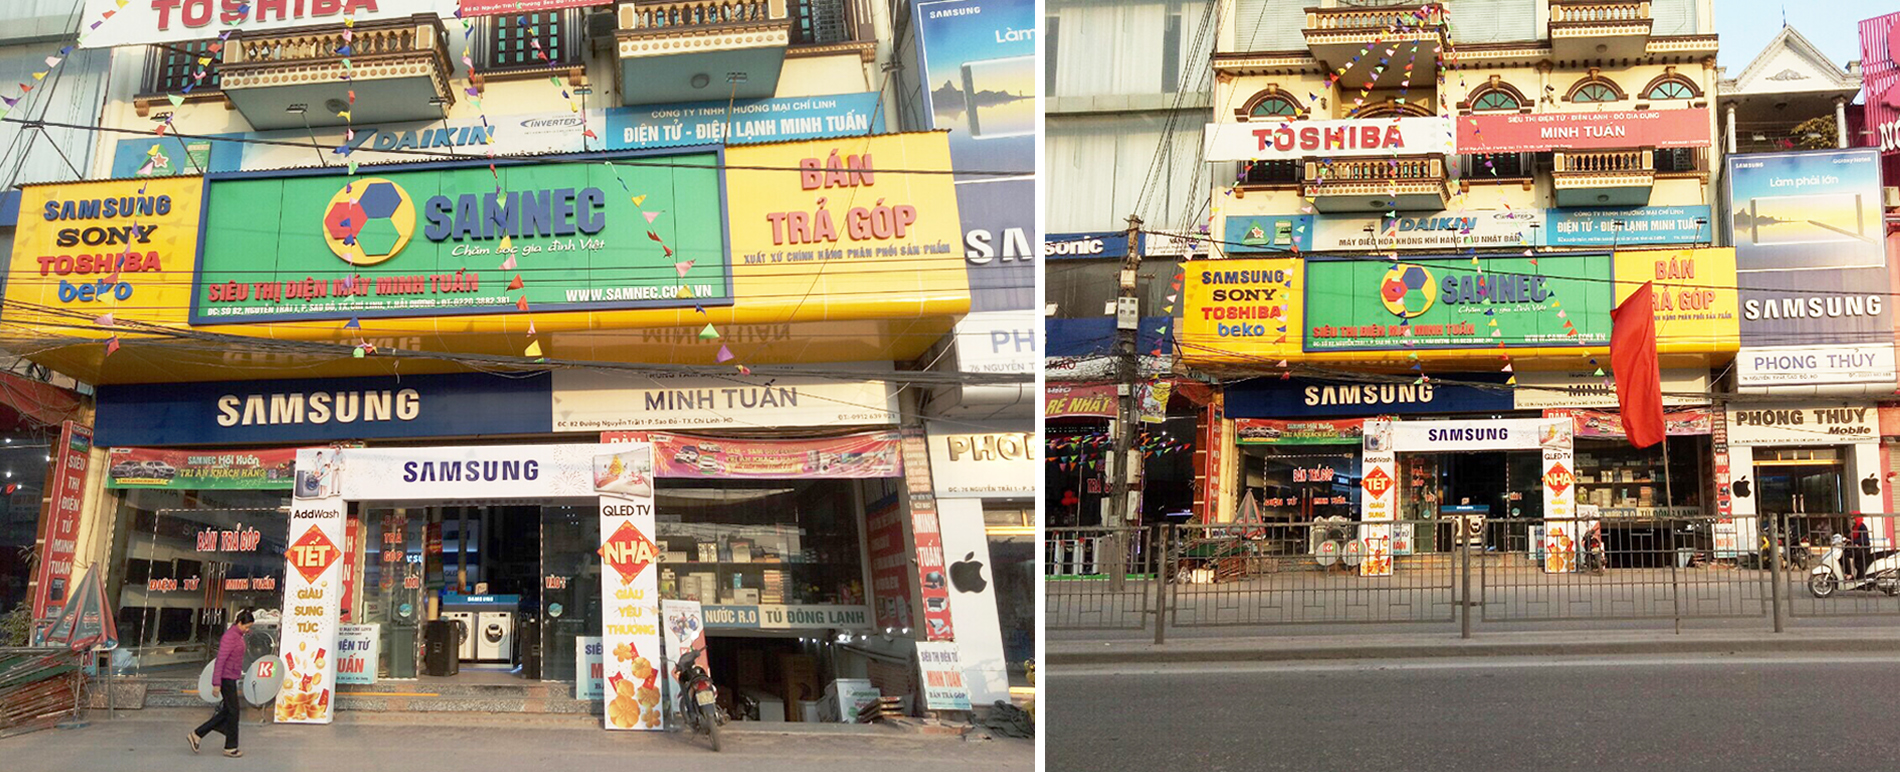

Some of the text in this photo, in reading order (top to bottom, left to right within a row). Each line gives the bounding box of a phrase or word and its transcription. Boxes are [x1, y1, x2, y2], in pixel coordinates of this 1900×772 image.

[930, 6, 981, 19] SAMSUNG
[651, 110, 680, 119] CÔNG
[683, 109, 696, 117] TY
[698, 107, 725, 116] TNHH
[793, 99, 811, 111] CHÍ
[813, 99, 836, 109] LINH
[531, 118, 577, 128] INVERTER
[624, 123, 659, 145] ĐIỆN
[662, 118, 683, 141] TỬ
[736, 119, 776, 140] LẠNH
[780, 116, 826, 134] MINH
[826, 109, 868, 132] TUẤN
[1508, 115, 1523, 123] SIÊU
[372, 125, 495, 150] DAIKIN
[1252, 125, 1405, 152] TOSHIBA
[1540, 121, 1626, 139] MINH TUẤN
[800, 148, 875, 191] BÁN
[1769, 177, 1793, 188] Làm
[1821, 174, 1839, 185] lớn
[43, 194, 171, 221] SAMSUNG
[425, 187, 605, 242] SAMNEC
[766, 196, 917, 245] TRẢ GÓP
[1398, 217, 1477, 232] DAIKIN
[1557, 217, 1675, 234] ĐIỆN TỬ LẠNH MINH
[57, 225, 158, 247] SONY
[1396, 236, 1423, 245] KHÔNG
[1424, 235, 1438, 244] KHÍ
[451, 239, 605, 257] Chăm gia đình Việt
[1045, 236, 1104, 255] sonic
[37, 251, 162, 276] TOSHIBA
[744, 251, 766, 265] XUẤT
[787, 249, 814, 262] CHÍNH
[1655, 255, 1695, 280] BÁN
[208, 267, 479, 303] SIÊU THỊ ĐIỆN MÁY MINH TUẤN
[1201, 270, 1285, 285] SAMSUNG
[1212, 288, 1277, 301] SONY
[1441, 274, 1547, 305] SAMNEC
[1679, 287, 1716, 311] GÓP
[1744, 295, 1882, 320] SAMSUNG
[1201, 305, 1282, 320] TOSHIBA
[1218, 322, 1265, 337] beko
[1312, 320, 1475, 340] SIÊU THỊ ĐIỆN MINH TUẤN
[984, 359, 1025, 371] NGUYỄN
[1754, 347, 1876, 370] PHONG THỦY
[645, 378, 798, 411] MINH TUẤN
[1068, 391, 1113, 413] NHẤT
[1304, 382, 1434, 406] SAMSUNG
[217, 388, 420, 427] SAMSUNG
[1736, 409, 1804, 426] PHONG
[1428, 427, 1509, 442] SAMSUNG
[1829, 426, 1872, 435] Mobile
[68, 454, 86, 471] SIÊU
[187, 456, 216, 465] SAMNEC
[1560, 452, 1572, 460] TV
[403, 459, 540, 482] SAMSUNG
[1545, 469, 1574, 486] NHÀ
[67, 476, 80, 494] THỊ
[1365, 472, 1388, 490] TẾT
[293, 509, 340, 520] AddWash
[603, 504, 651, 517] QLED TV
[914, 514, 938, 533] MINH
[196, 527, 218, 552] BÁN
[221, 522, 239, 551] TRẢ
[240, 526, 260, 551] GÓP
[294, 536, 331, 567] TẾT
[383, 550, 403, 562] GÓP
[604, 536, 654, 564] NHÀ
[916, 540, 941, 568] TUẤN
[50, 556, 71, 574] TUẤN
[149, 577, 177, 593] ĐIỆN
[183, 575, 200, 591] TỬ
[225, 578, 249, 591] MINH
[615, 586, 644, 600] GIÀU
[297, 587, 323, 600] GIÀU
[294, 606, 323, 617] SUNG
[618, 606, 643, 618] YÊU
[704, 607, 735, 623] NƯỚC
[738, 609, 757, 623] R.O
[765, 607, 782, 623] TỦ
[786, 607, 825, 624] ĐÔNG
[829, 610, 865, 626] LẠNH
[606, 623, 656, 636] THƯƠNG
[357, 637, 371, 651] TỬ
[927, 665, 963, 687] MINH TUẤN
